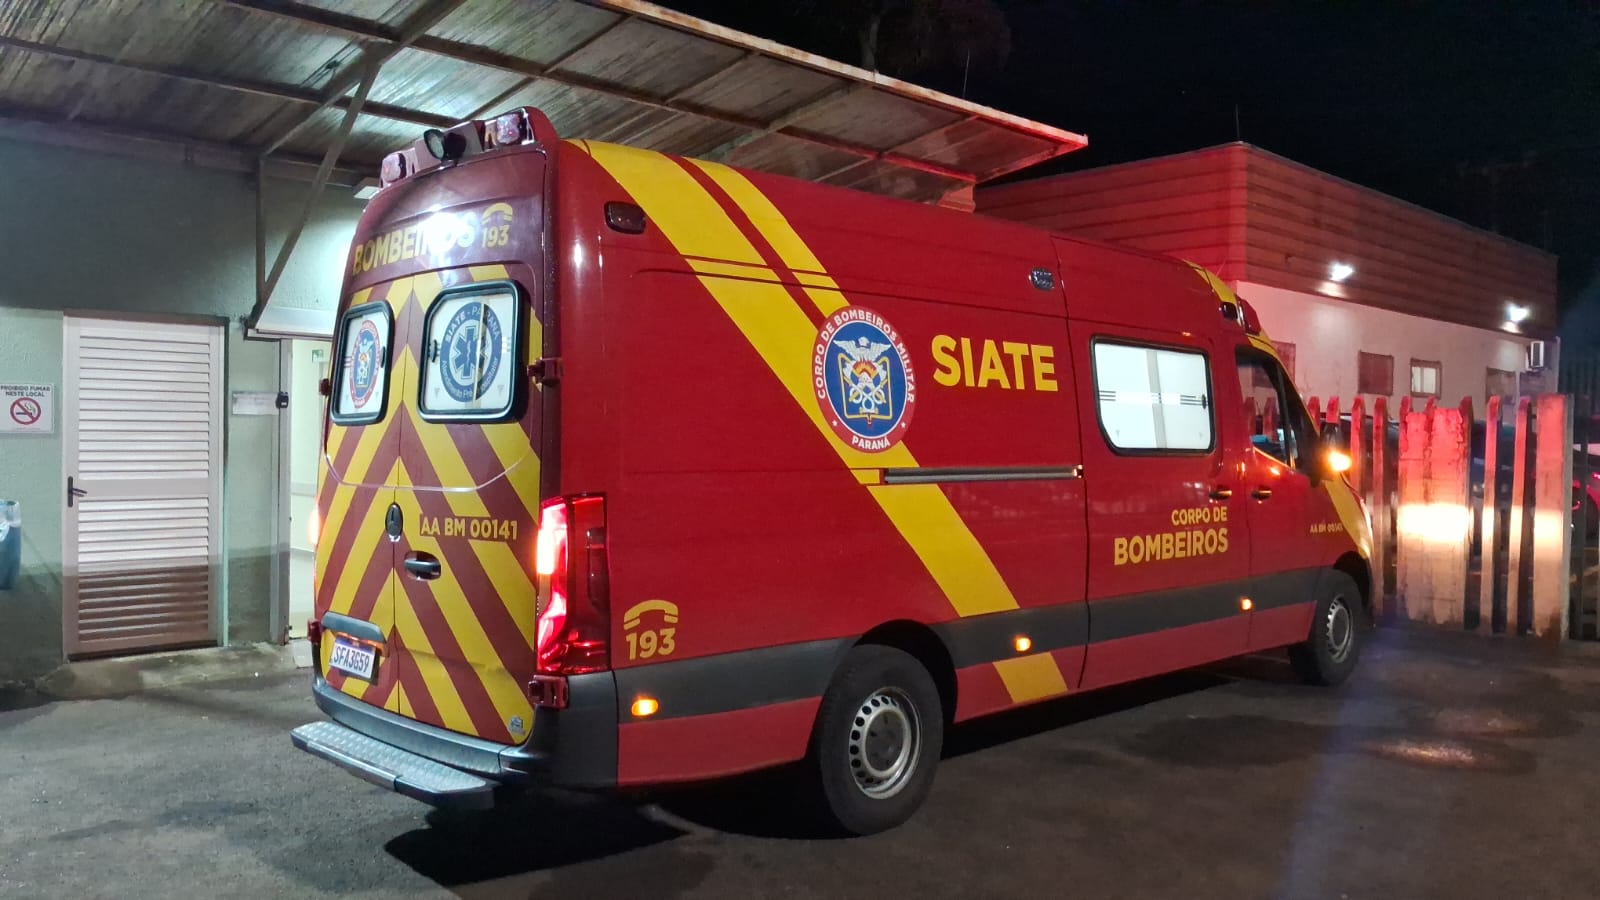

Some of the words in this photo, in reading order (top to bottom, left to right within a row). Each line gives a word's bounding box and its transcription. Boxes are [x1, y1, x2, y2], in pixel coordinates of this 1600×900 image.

[482, 224, 510, 248] 193
[445, 311, 466, 343] SIATE
[814, 343, 826, 399] CORPO
[821, 322, 835, 341] DE
[834, 309, 897, 341] BOMBEIROS
[897, 343, 915, 403] MILITAR
[931, 334, 1059, 392] SIATE
[852, 435, 891, 450] PARANÁ
[421, 516, 440, 536] AA
[444, 517, 466, 537] BM
[470, 518, 518, 540] 00141
[1171, 507, 1211, 526] CORPO
[1213, 506, 1228, 522] DE
[1114, 527, 1229, 566] BOMBEIROS
[625, 627, 676, 660] 193
[333, 646, 370, 673] SFA3G59
